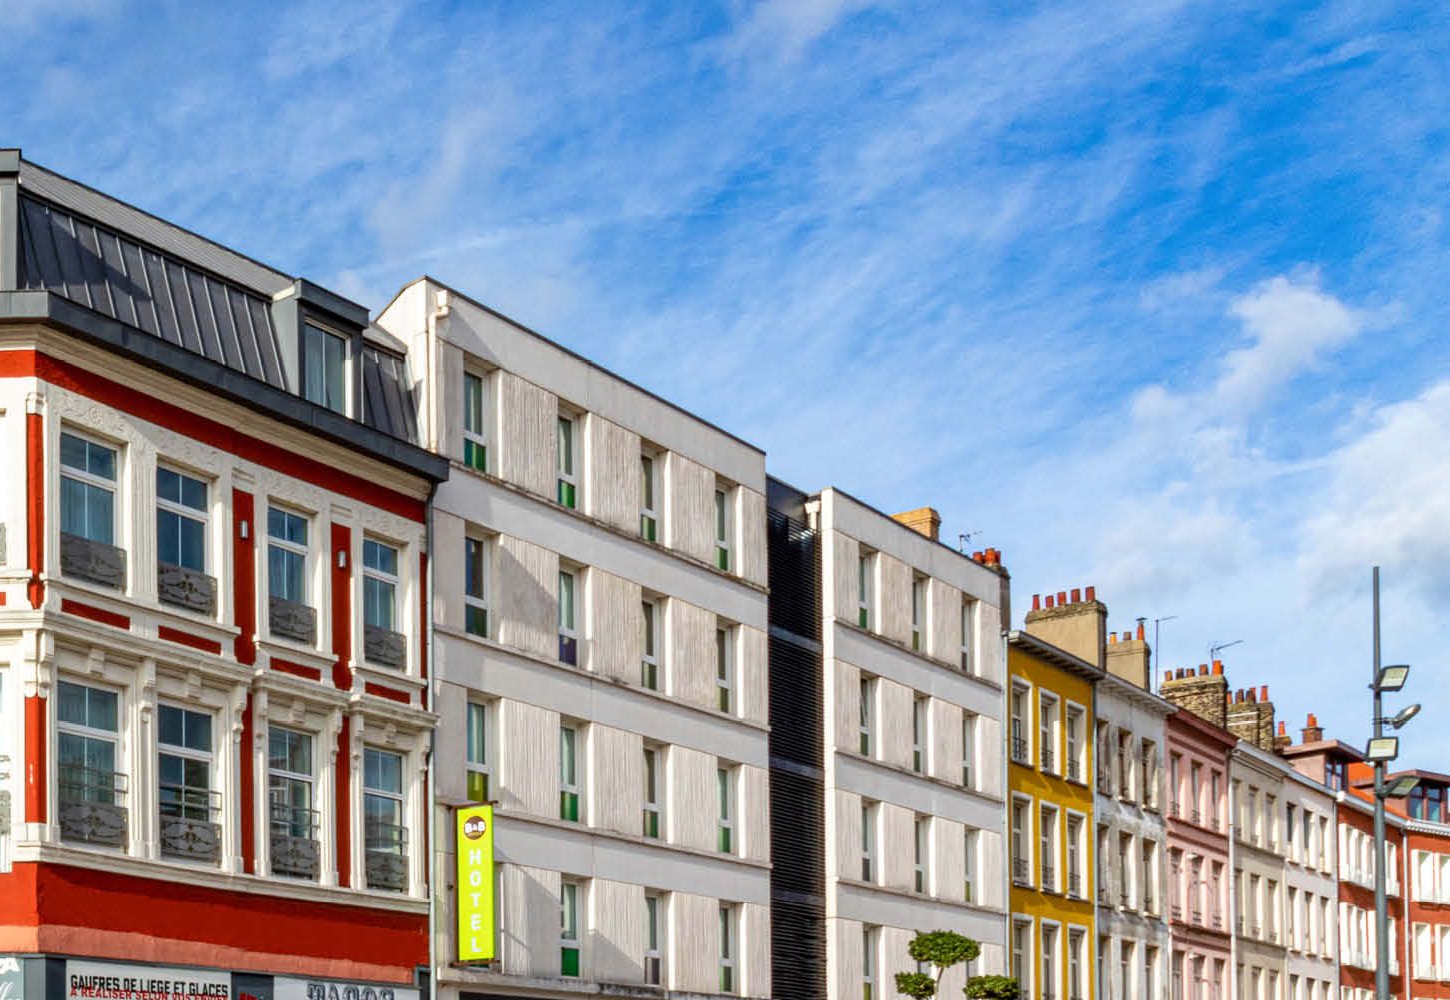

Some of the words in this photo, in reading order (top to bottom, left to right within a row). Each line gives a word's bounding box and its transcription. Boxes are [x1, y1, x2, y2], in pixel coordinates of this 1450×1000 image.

[468, 848, 482, 952] HOTEL
[70, 974, 120, 992] GAUFRES
[123, 978, 137, 993] DE
[173, 981, 186, 995] ET
[189, 983, 229, 997] GLACES
